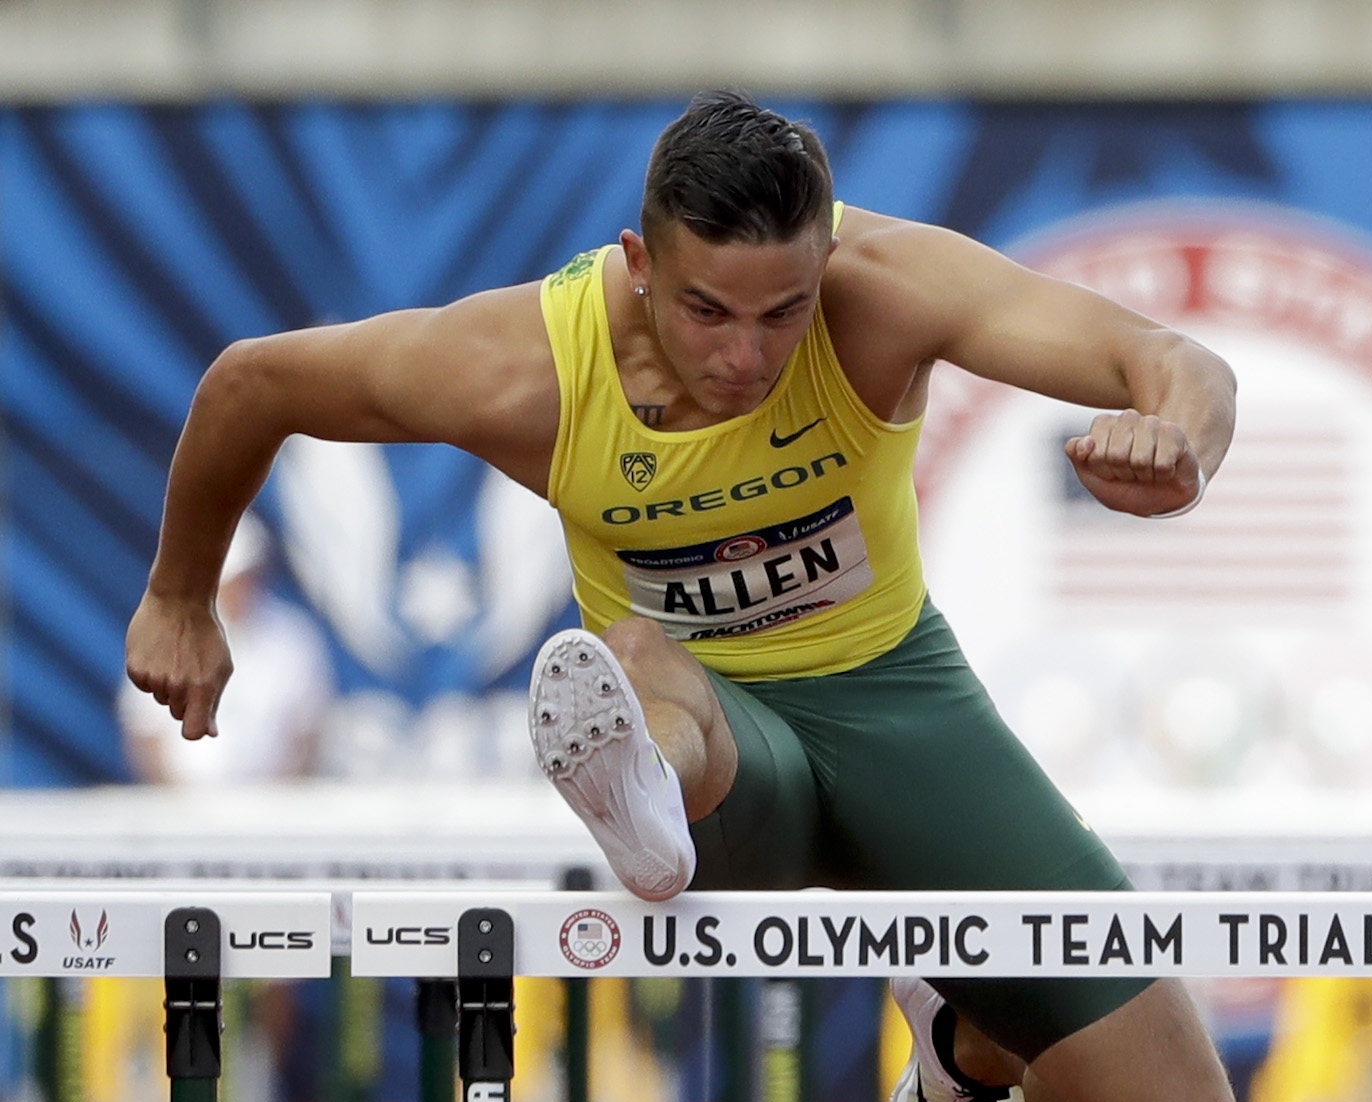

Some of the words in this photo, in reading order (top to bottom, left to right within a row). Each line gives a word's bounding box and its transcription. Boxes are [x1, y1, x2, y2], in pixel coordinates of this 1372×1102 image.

[631, 470, 648, 484] 12
[602, 452, 848, 525] OREGON
[663, 537, 841, 617] ALLEN
[229, 931, 316, 950] UCS
[365, 926, 454, 947] UCS
[643, 915, 738, 967] U.S.
[753, 914, 991, 967] OLYMPIC
[1021, 913, 1184, 966] TEAM
[62, 956, 117, 970] USATF
